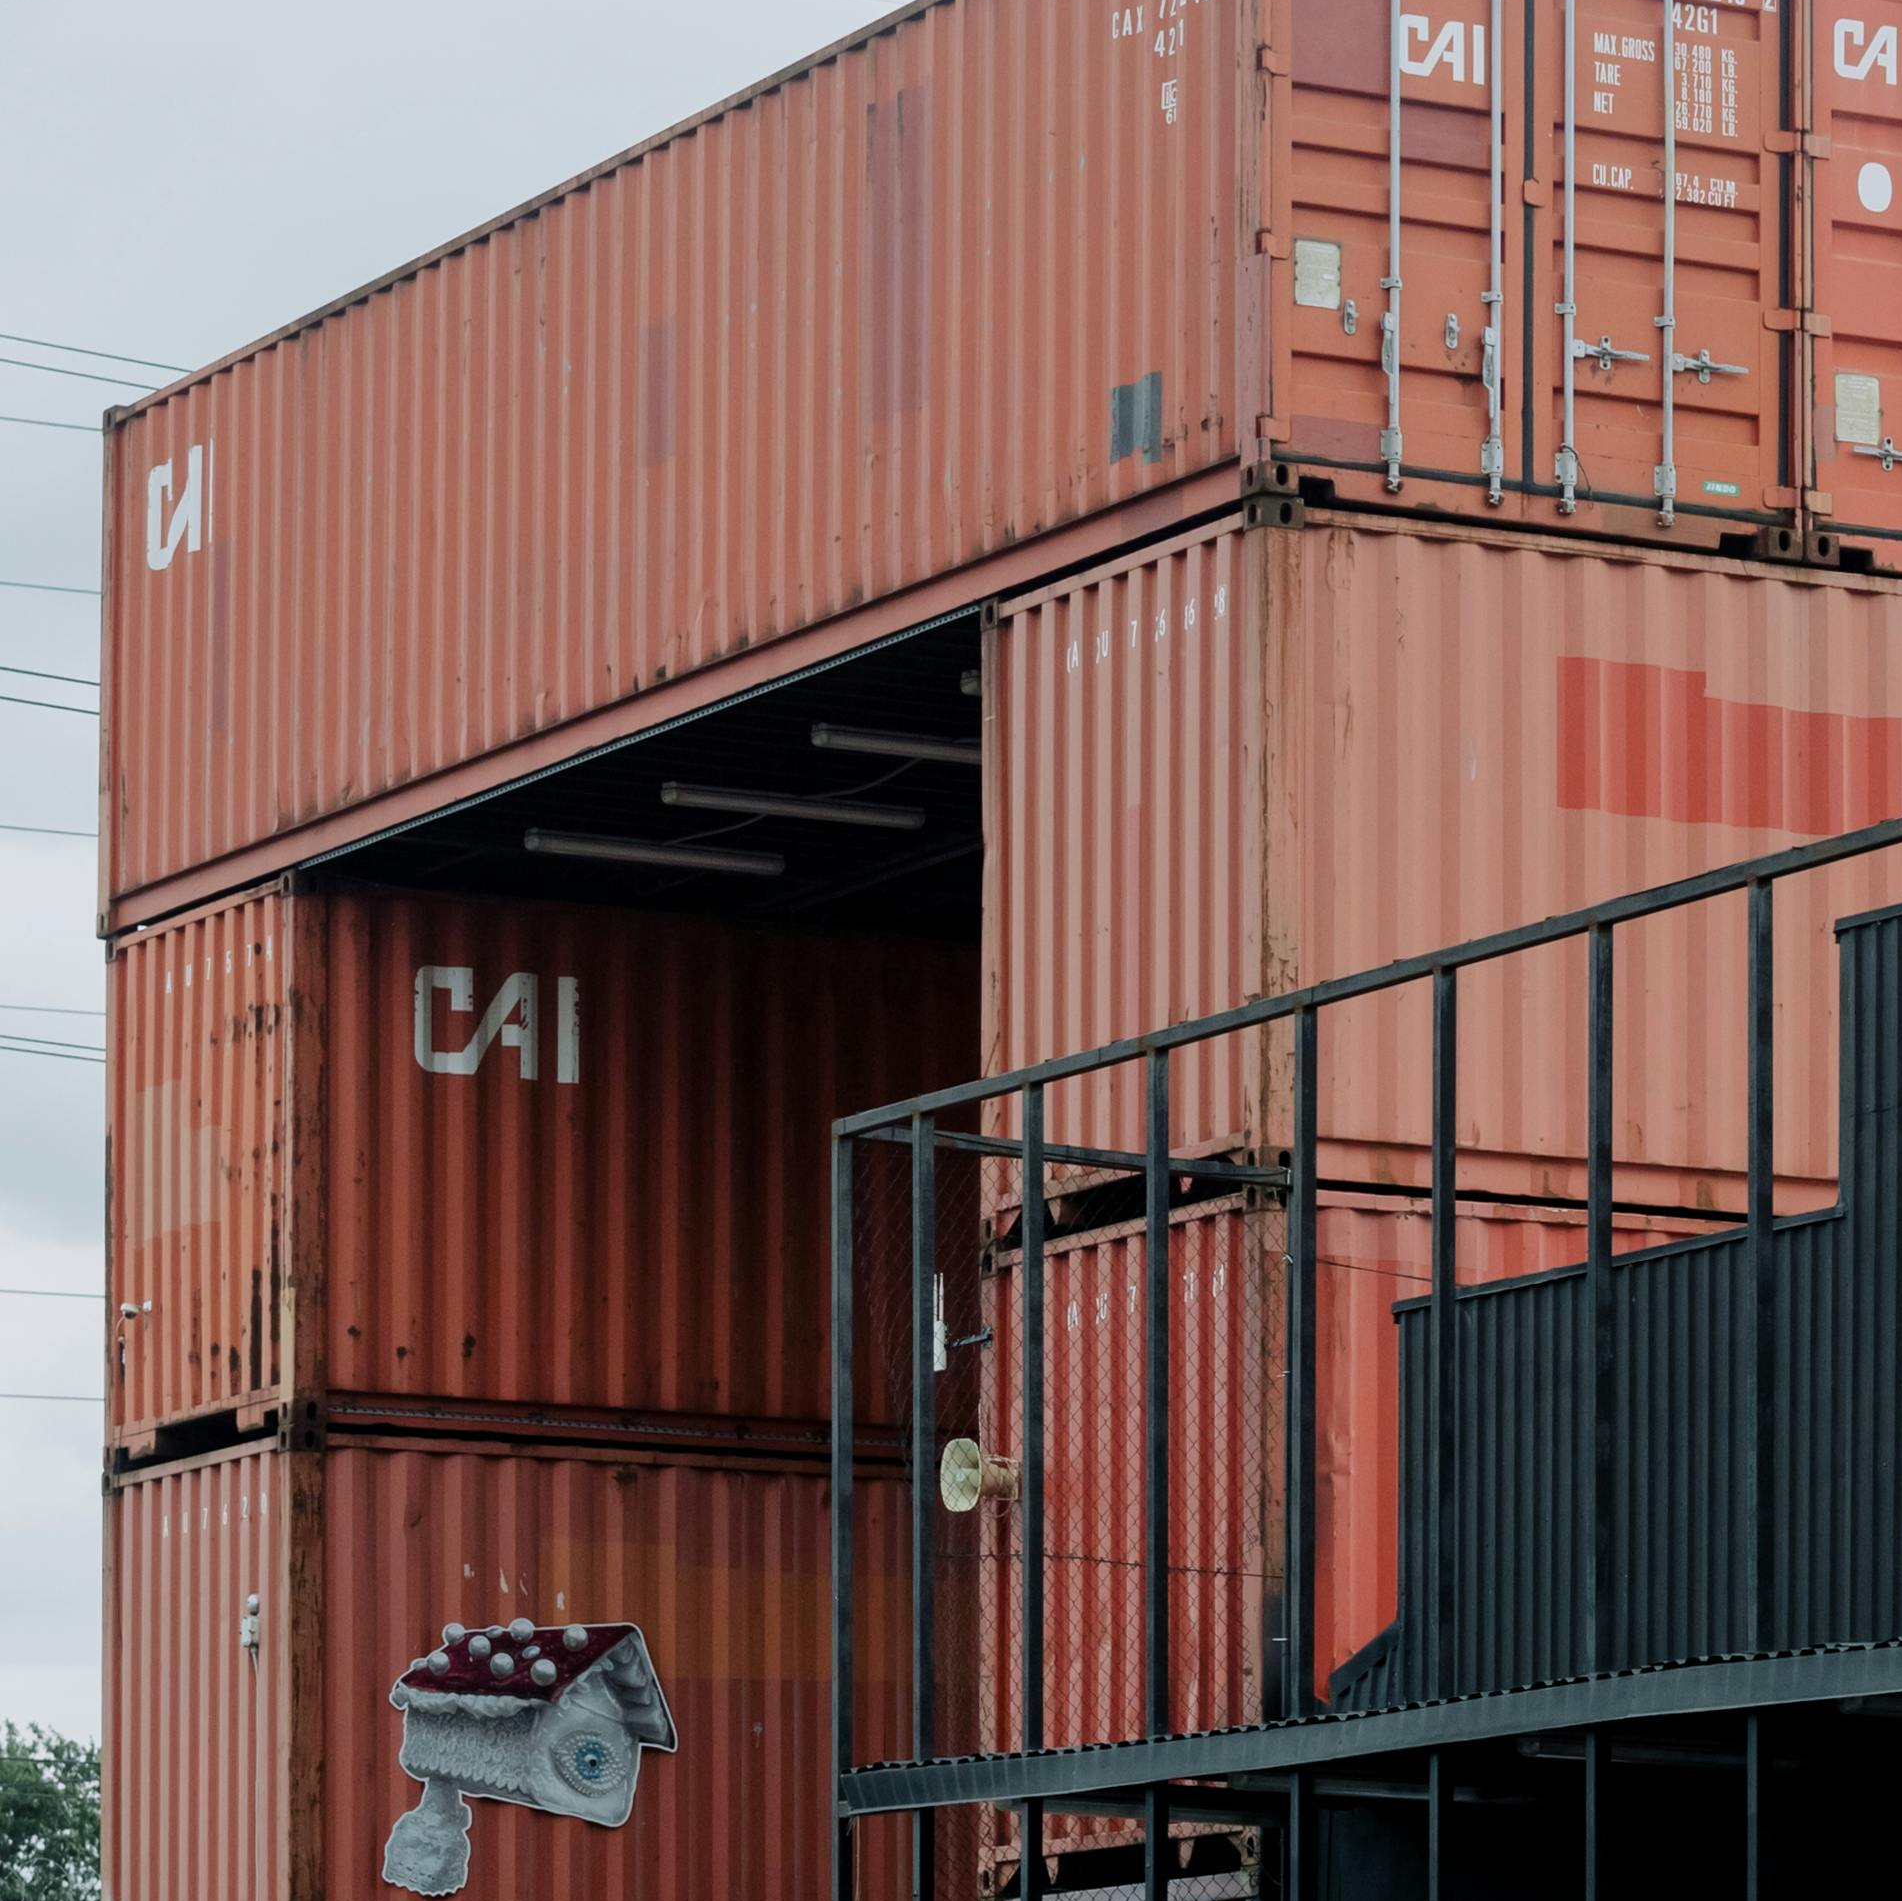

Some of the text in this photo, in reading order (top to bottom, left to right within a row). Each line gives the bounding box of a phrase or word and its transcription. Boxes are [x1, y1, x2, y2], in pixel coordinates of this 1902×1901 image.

[1673, 1, 1718, 35] 42G1
[1399, 14, 1486, 86] CAI
[1594, 61, 1621, 87] TARE
[1594, 91, 1614, 115] NET
[414, 965, 580, 1084] CAI
